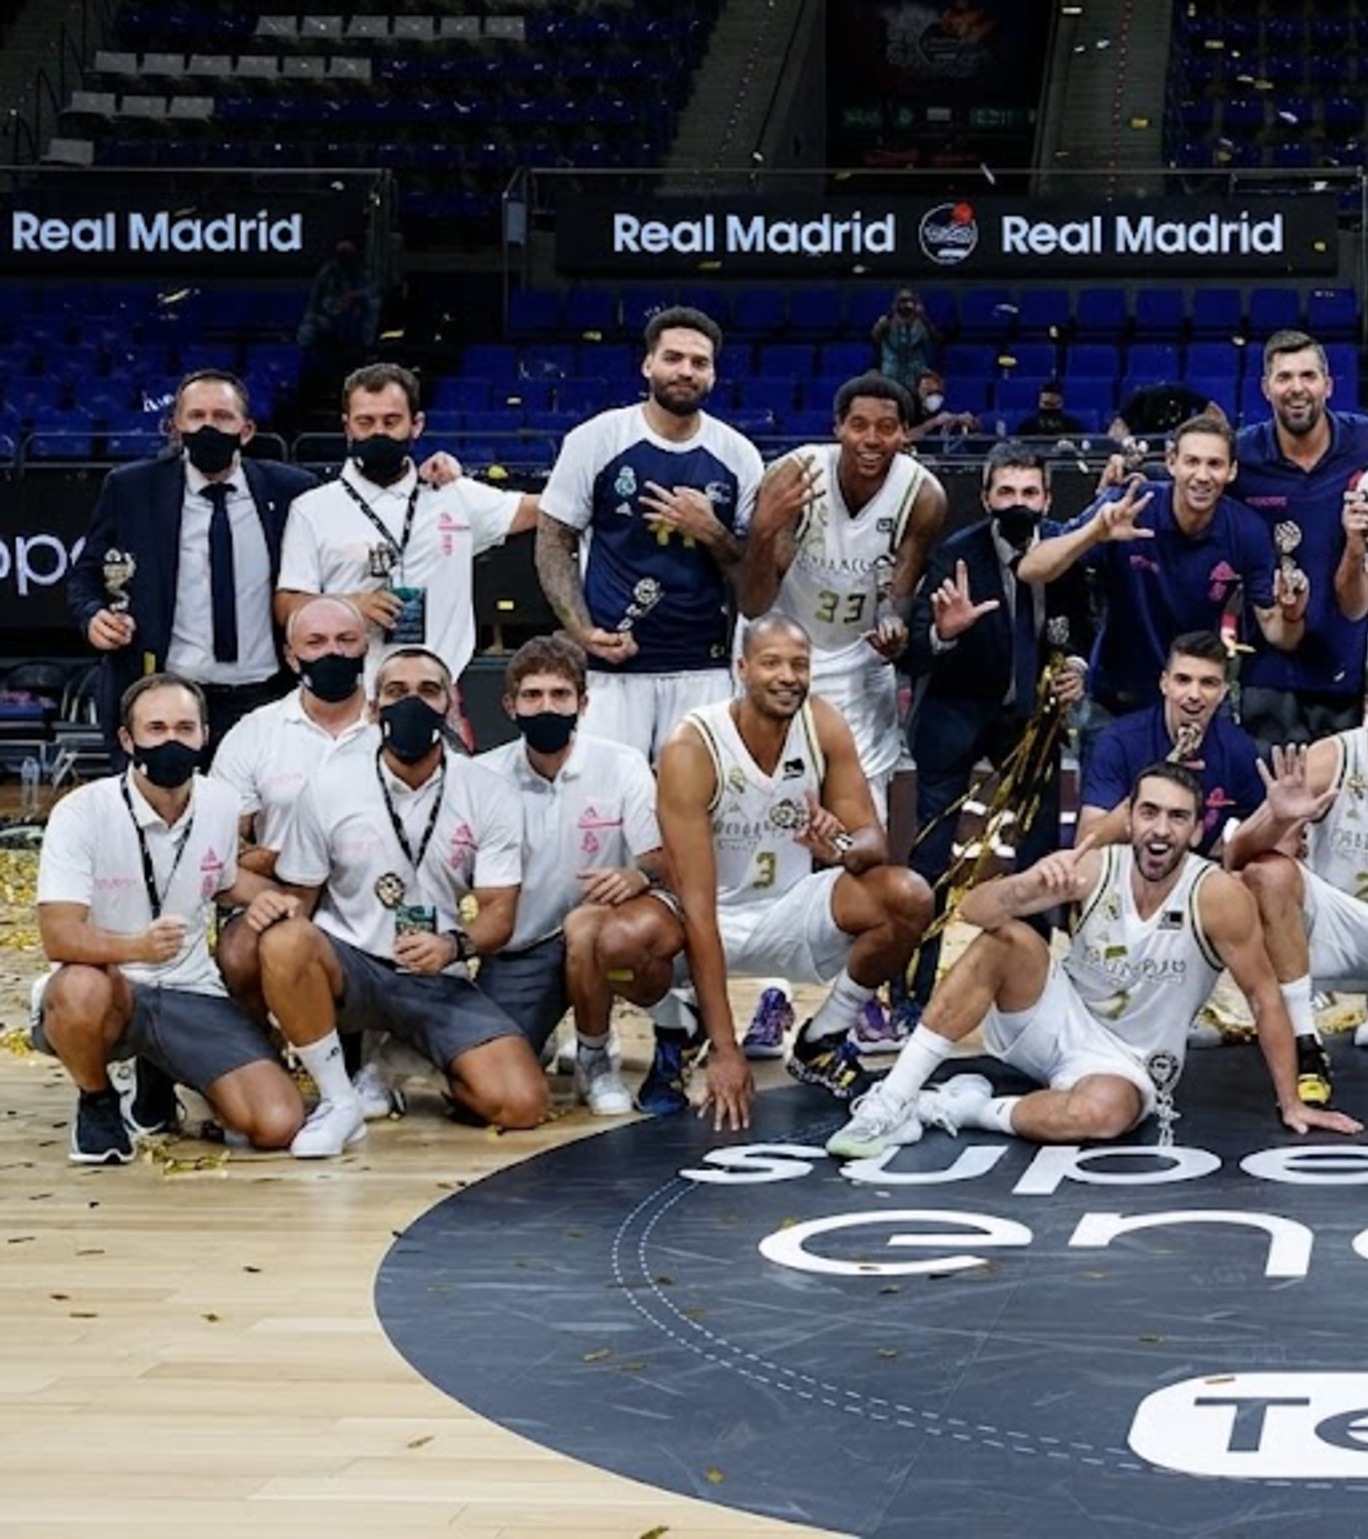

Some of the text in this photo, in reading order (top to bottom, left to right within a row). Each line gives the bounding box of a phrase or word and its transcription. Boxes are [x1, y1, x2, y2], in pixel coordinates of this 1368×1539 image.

[13, 211, 302, 252] Real Madrid
[614, 214, 715, 253] Real
[726, 212, 896, 254] Madrid
[1002, 215, 1102, 254] Real
[1116, 212, 1284, 254] Madrid
[814, 589, 867, 624] 33
[752, 851, 777, 890] 3
